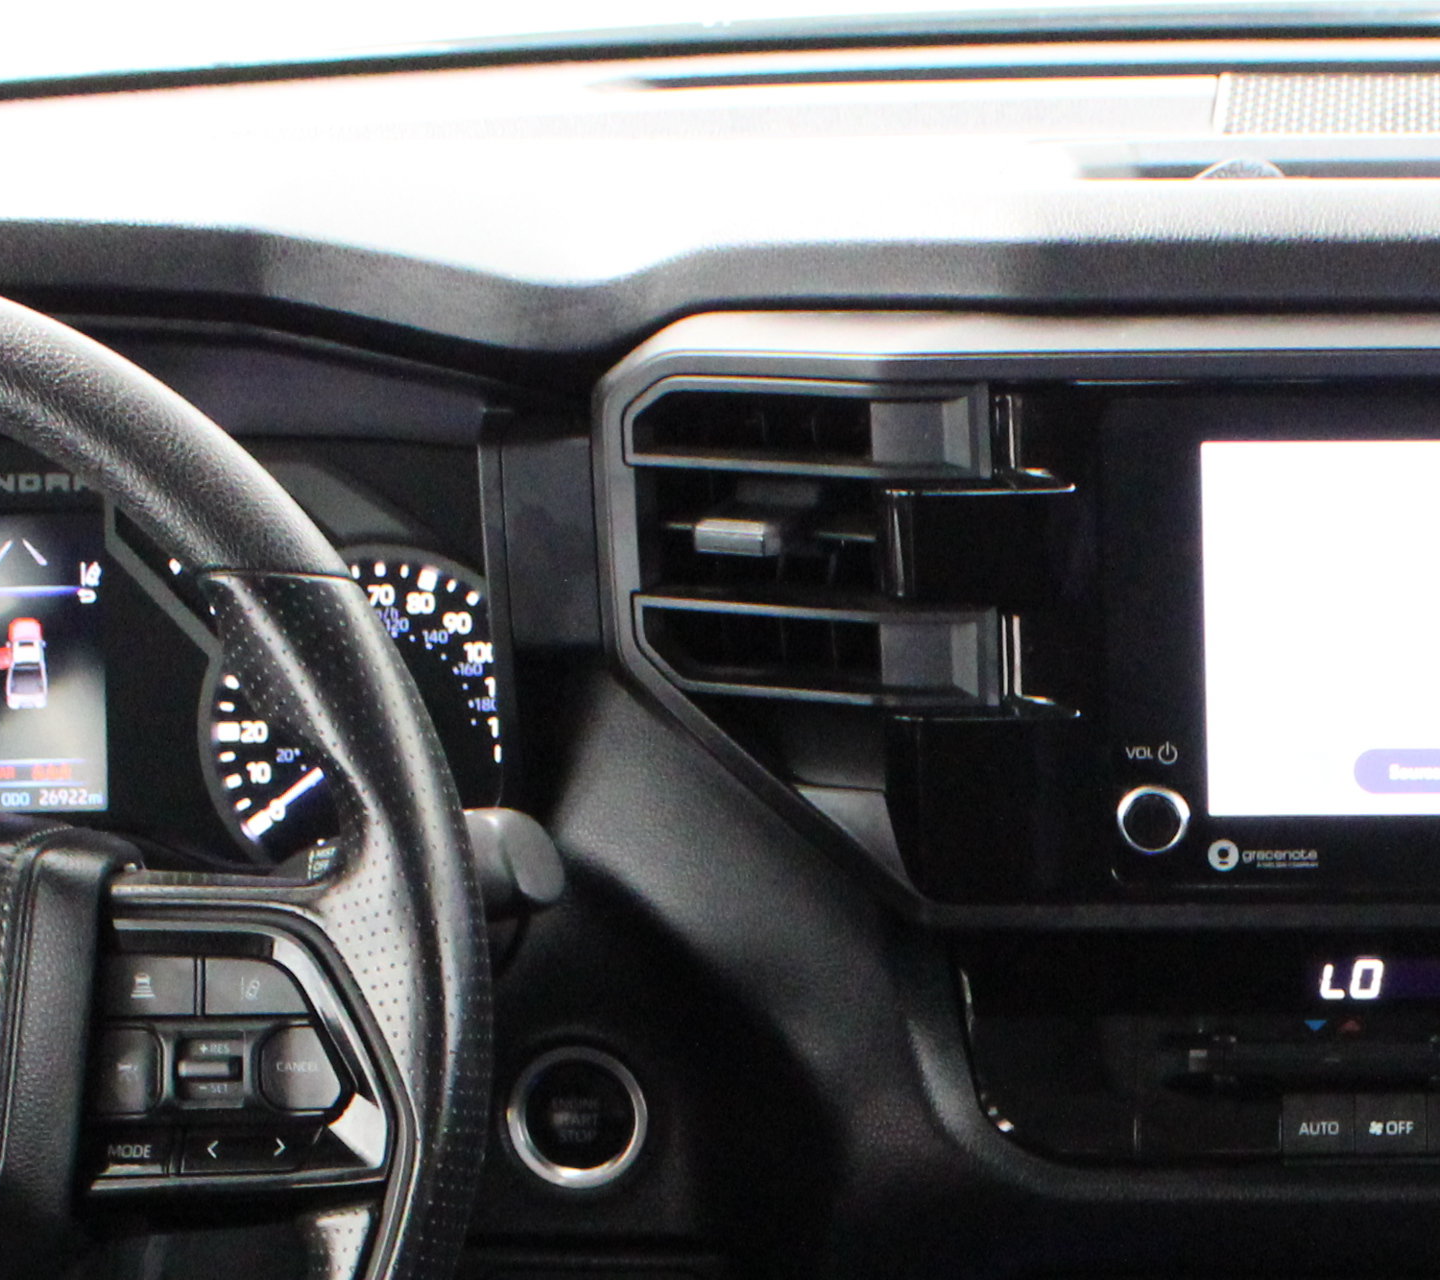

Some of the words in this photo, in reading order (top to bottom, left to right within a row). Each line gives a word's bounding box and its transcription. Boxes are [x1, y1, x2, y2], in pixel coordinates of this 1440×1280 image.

[367, 584, 396, 606] 70
[406, 592, 436, 614] 80
[442, 612, 473, 634] 90
[422, 629, 449, 645] 140
[458, 662, 484, 677] 160
[240, 720, 269, 743] 20
[1125, 746, 1153, 760] VOL
[246, 761, 272, 784] 10
[0, 792, 31, 807] ODO
[1241, 849, 1318, 865] gracenote
[1298, 1121, 1340, 1136] AUTO
[1385, 1121, 1414, 1135] OFF
